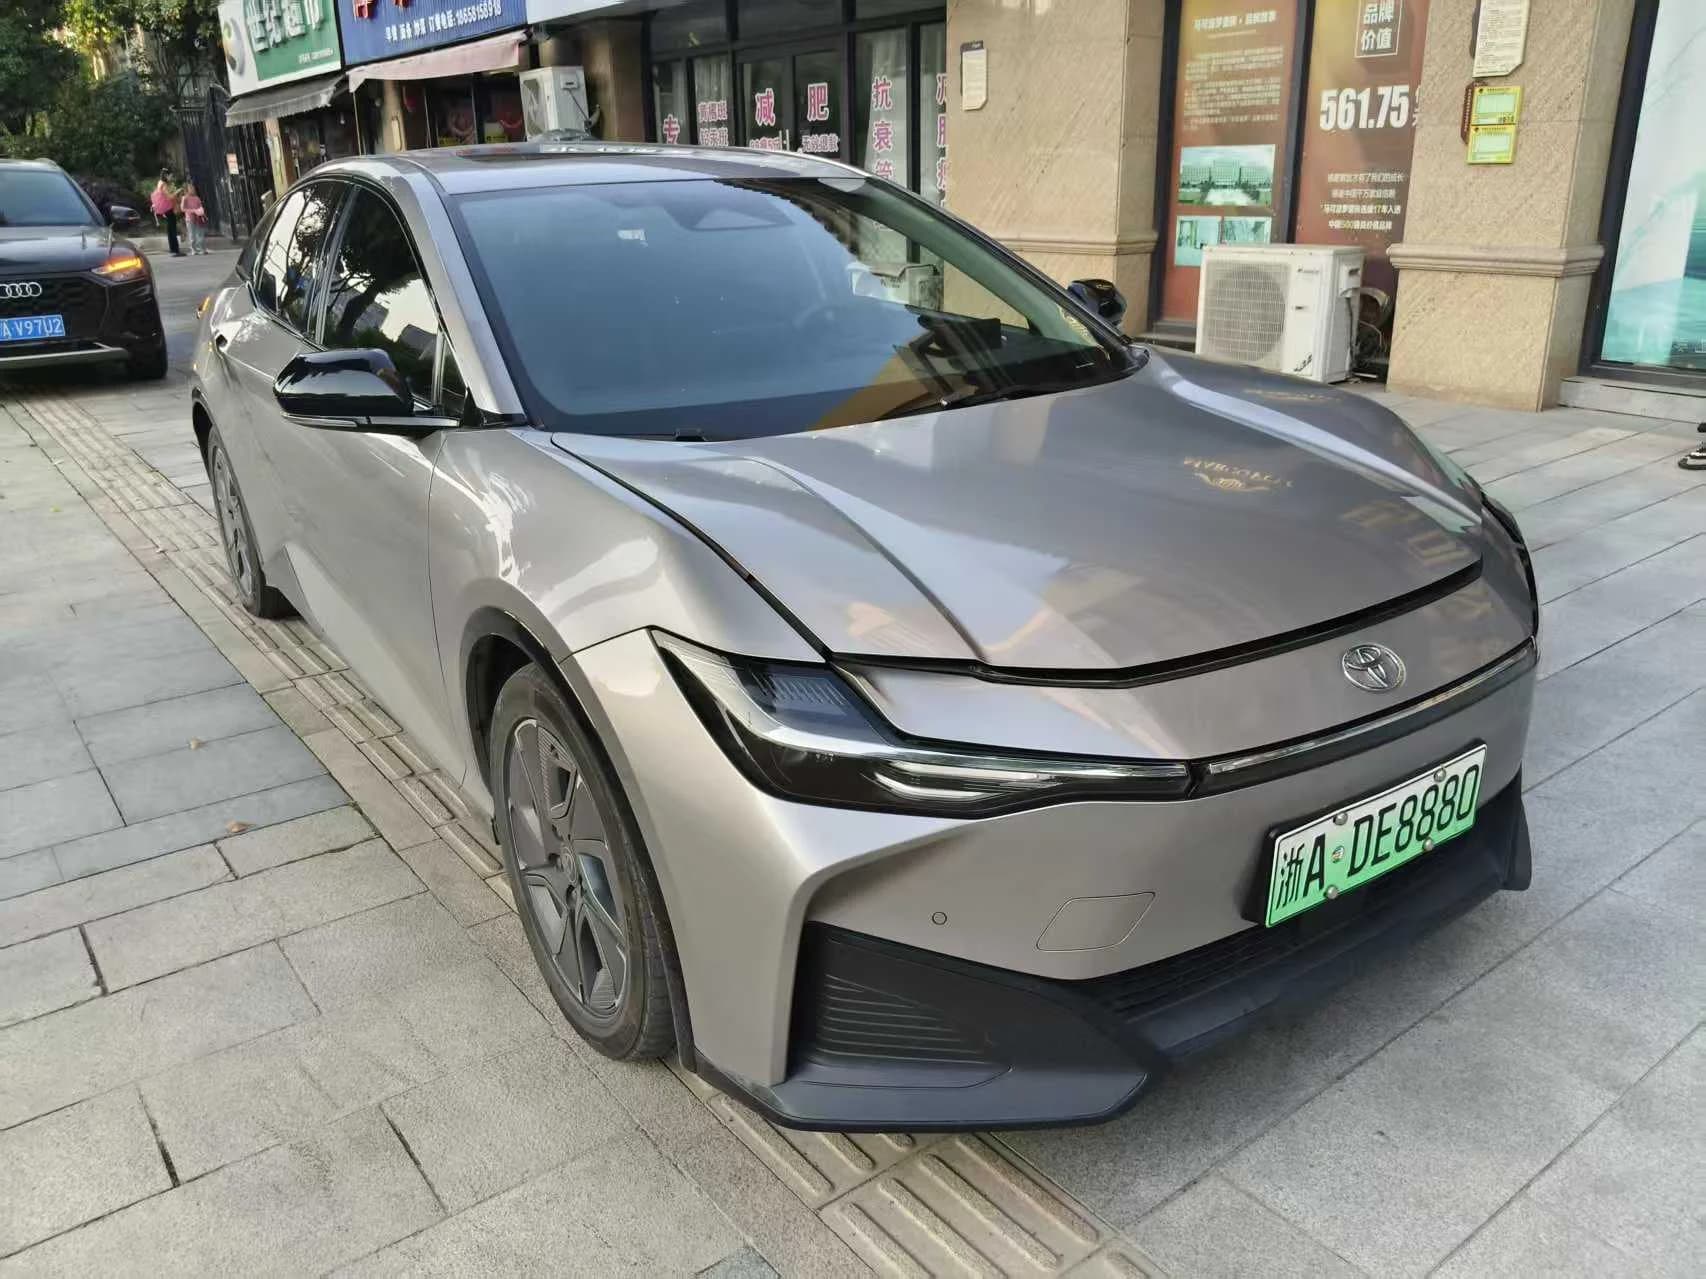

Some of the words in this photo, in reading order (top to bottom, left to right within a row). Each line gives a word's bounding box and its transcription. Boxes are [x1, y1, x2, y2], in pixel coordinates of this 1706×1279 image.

[1363, 1, 1394, 24] 品牌
[1361, 28, 1392, 51] 价值
[755, 88, 776, 127] 减
[806, 82, 829, 122] 肥
[1320, 84, 1409, 131] 561.75
[1275, 832, 1327, 910] 浙A
[1346, 763, 1480, 878] DE8880
